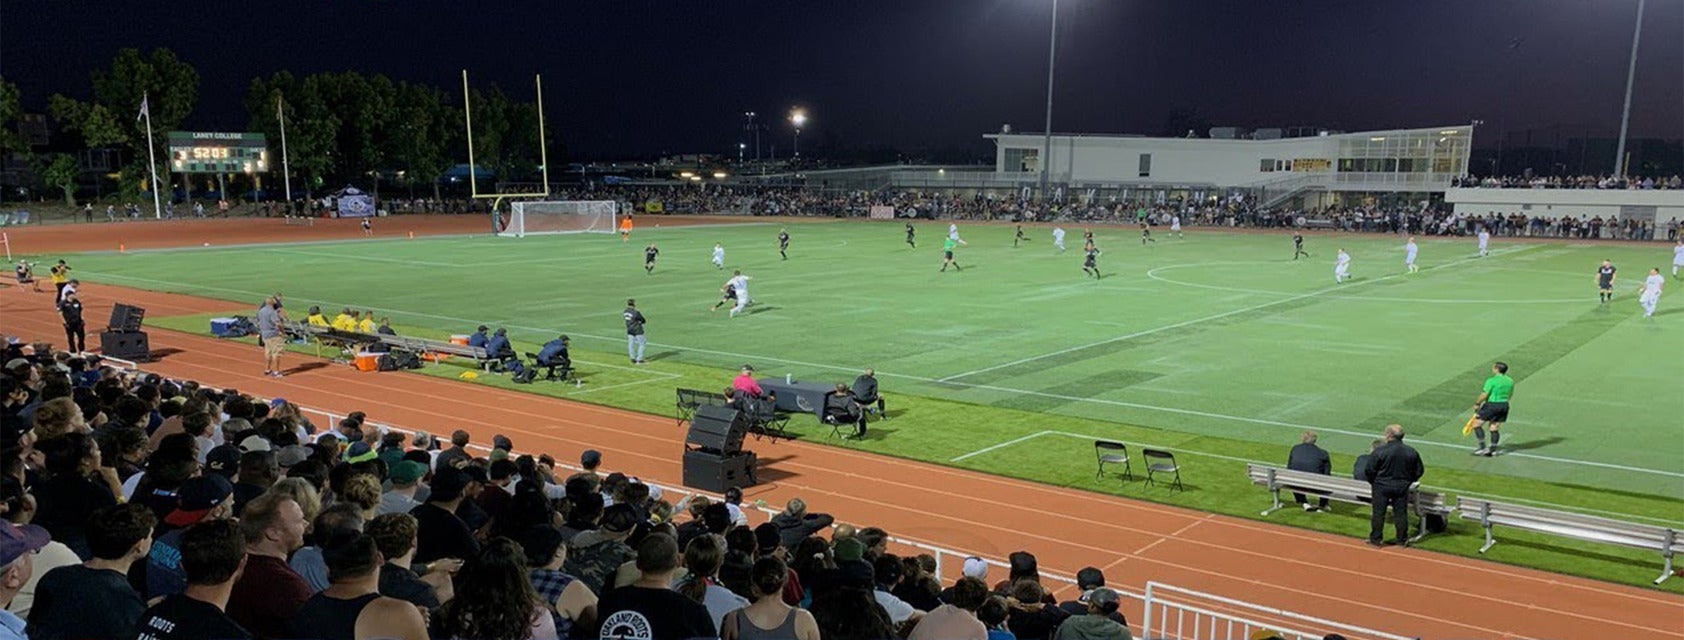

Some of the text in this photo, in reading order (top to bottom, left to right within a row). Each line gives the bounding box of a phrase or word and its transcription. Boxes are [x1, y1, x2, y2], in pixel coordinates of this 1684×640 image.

[148, 615, 175, 634] ROOTS
[602, 613, 649, 638] OAKLAND ROOTS
